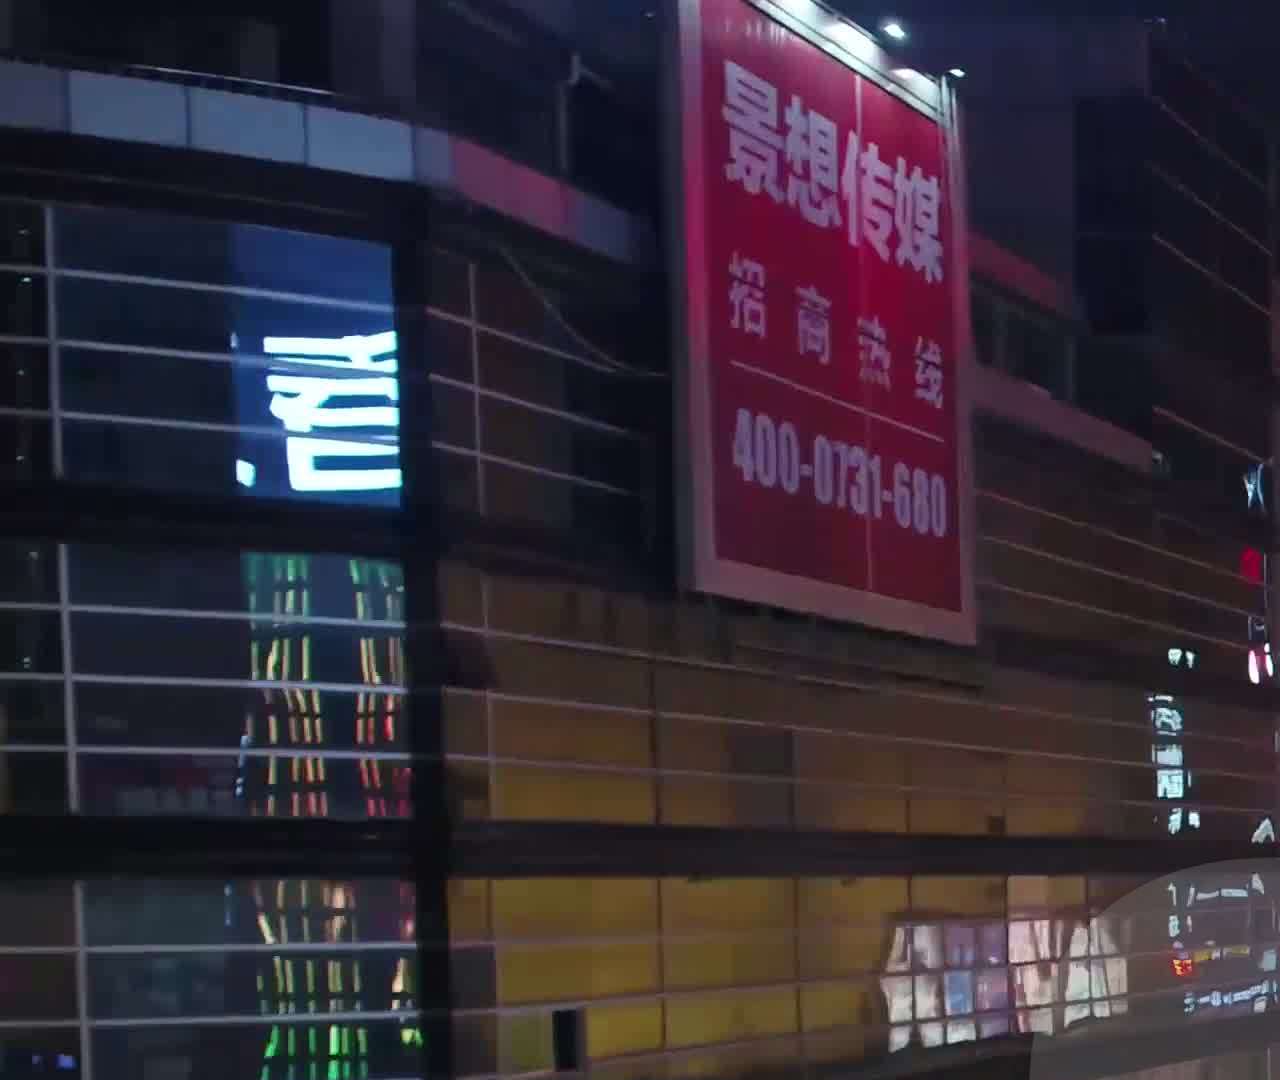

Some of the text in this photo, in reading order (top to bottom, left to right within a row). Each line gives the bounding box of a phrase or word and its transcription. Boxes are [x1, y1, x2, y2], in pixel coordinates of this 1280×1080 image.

[722, 59, 945, 285] 景想传媒
[728, 250, 944, 410] 招商热线
[732, 407, 948, 538] 400-0731-680
